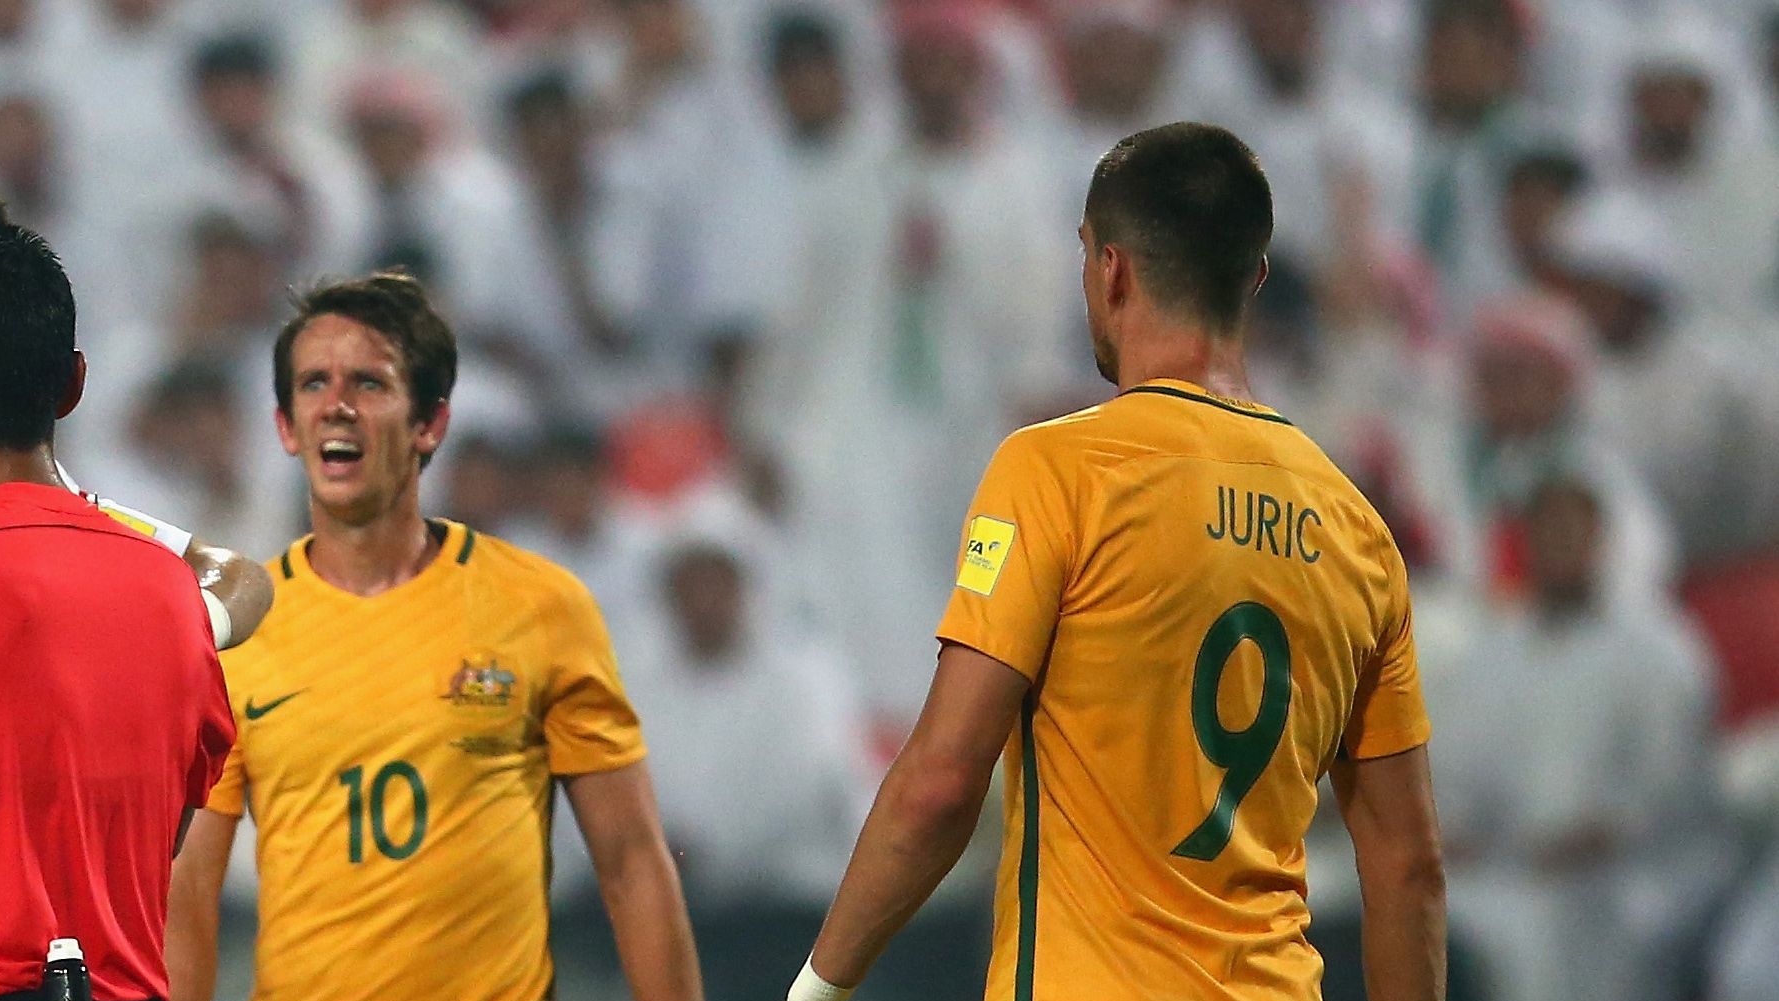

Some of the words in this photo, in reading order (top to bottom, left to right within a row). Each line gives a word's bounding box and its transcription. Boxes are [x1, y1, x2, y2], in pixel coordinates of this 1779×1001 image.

[1206, 485, 1323, 564] JURIC
[1170, 600, 1292, 862] 9
[339, 759, 429, 864] 10
